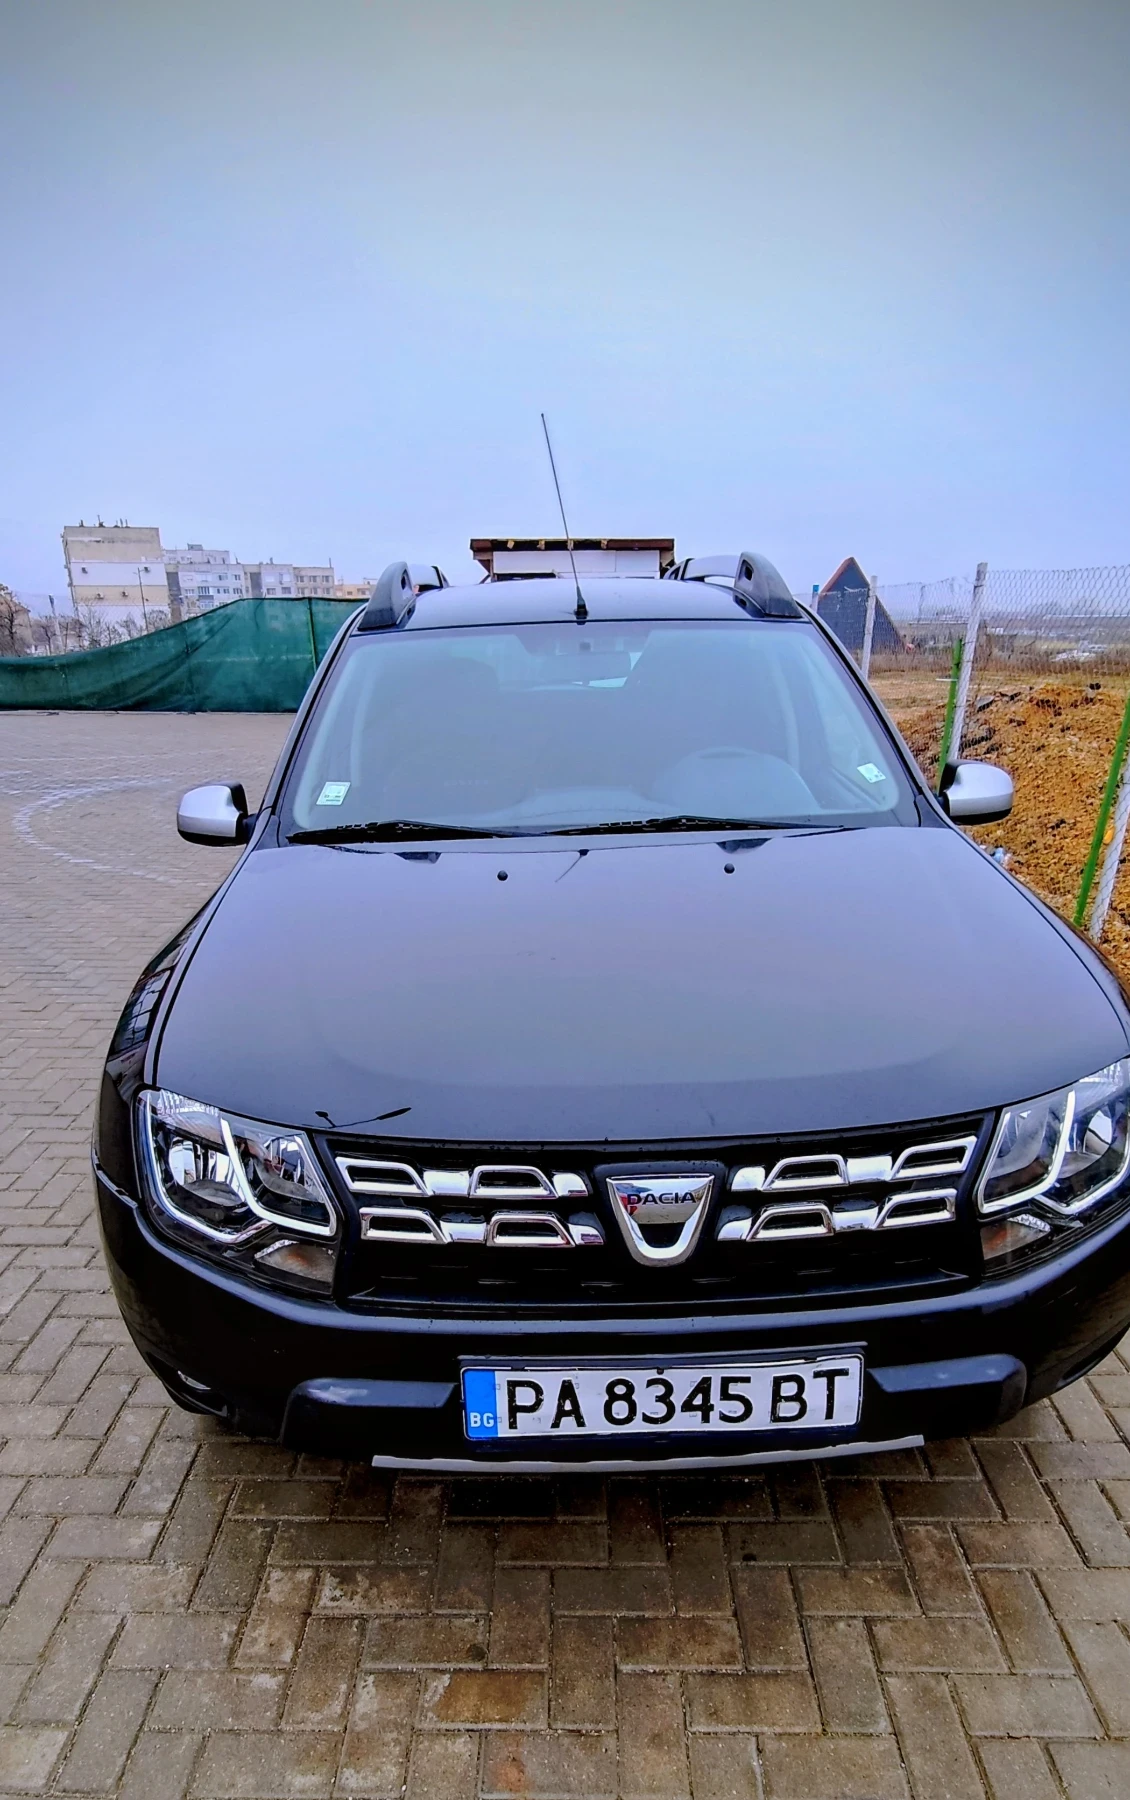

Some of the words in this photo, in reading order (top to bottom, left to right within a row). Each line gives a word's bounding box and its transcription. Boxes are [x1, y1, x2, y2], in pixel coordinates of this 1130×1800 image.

[626, 1191, 697, 1206] DACIA
[507, 1380, 587, 1430] PA
[603, 1376, 753, 1426] 8345
[770, 1368, 850, 1424] BT
[469, 1413, 495, 1428] BG
